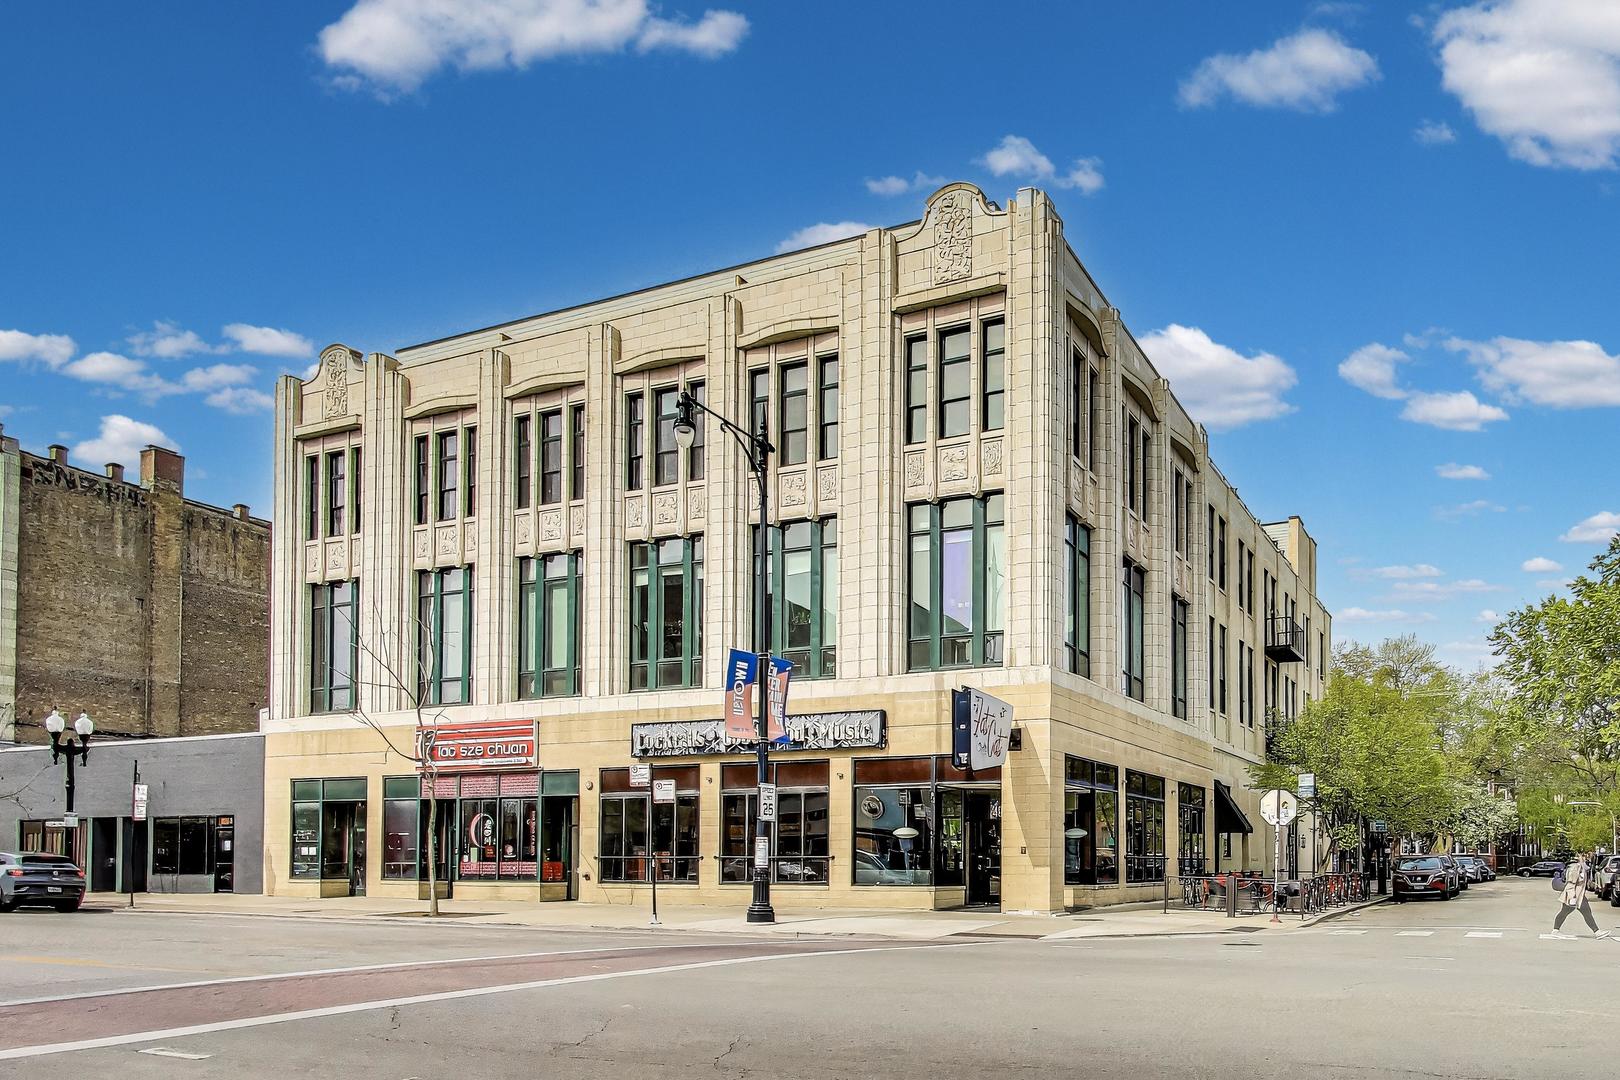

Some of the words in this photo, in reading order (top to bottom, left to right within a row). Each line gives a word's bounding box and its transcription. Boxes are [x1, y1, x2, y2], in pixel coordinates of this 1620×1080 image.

[733, 661, 748, 716] UPTOWN
[638, 727, 705, 750] Cocktails
[821, 719, 872, 740] Music
[460, 745, 483, 756] sze
[487, 743, 528, 755] chuan
[763, 803, 774, 815] 25
